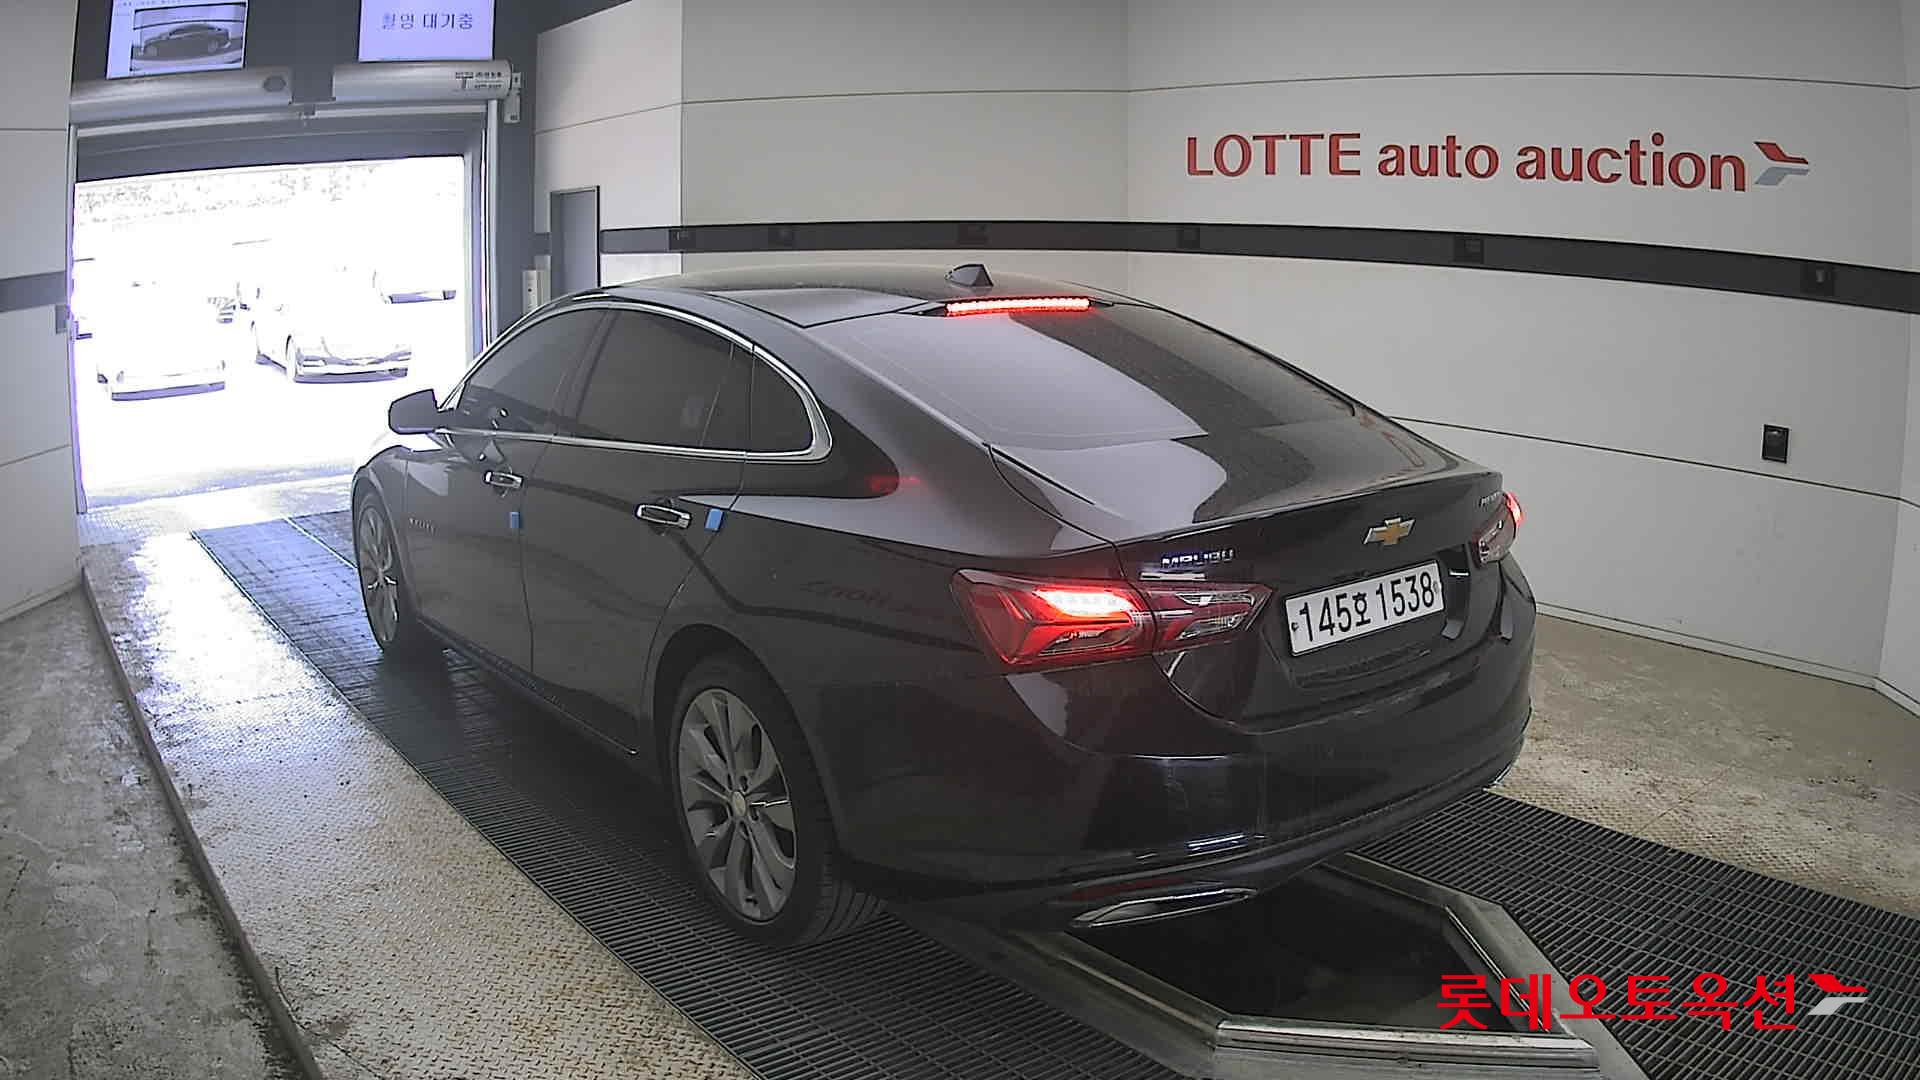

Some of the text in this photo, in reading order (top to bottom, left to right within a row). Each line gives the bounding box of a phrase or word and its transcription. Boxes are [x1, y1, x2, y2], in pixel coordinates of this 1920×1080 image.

[422, 12, 473, 31] 대기중
[1186, 131, 1747, 192] LOTTE auto auction
[1299, 571, 1435, 642] 145호 1538
